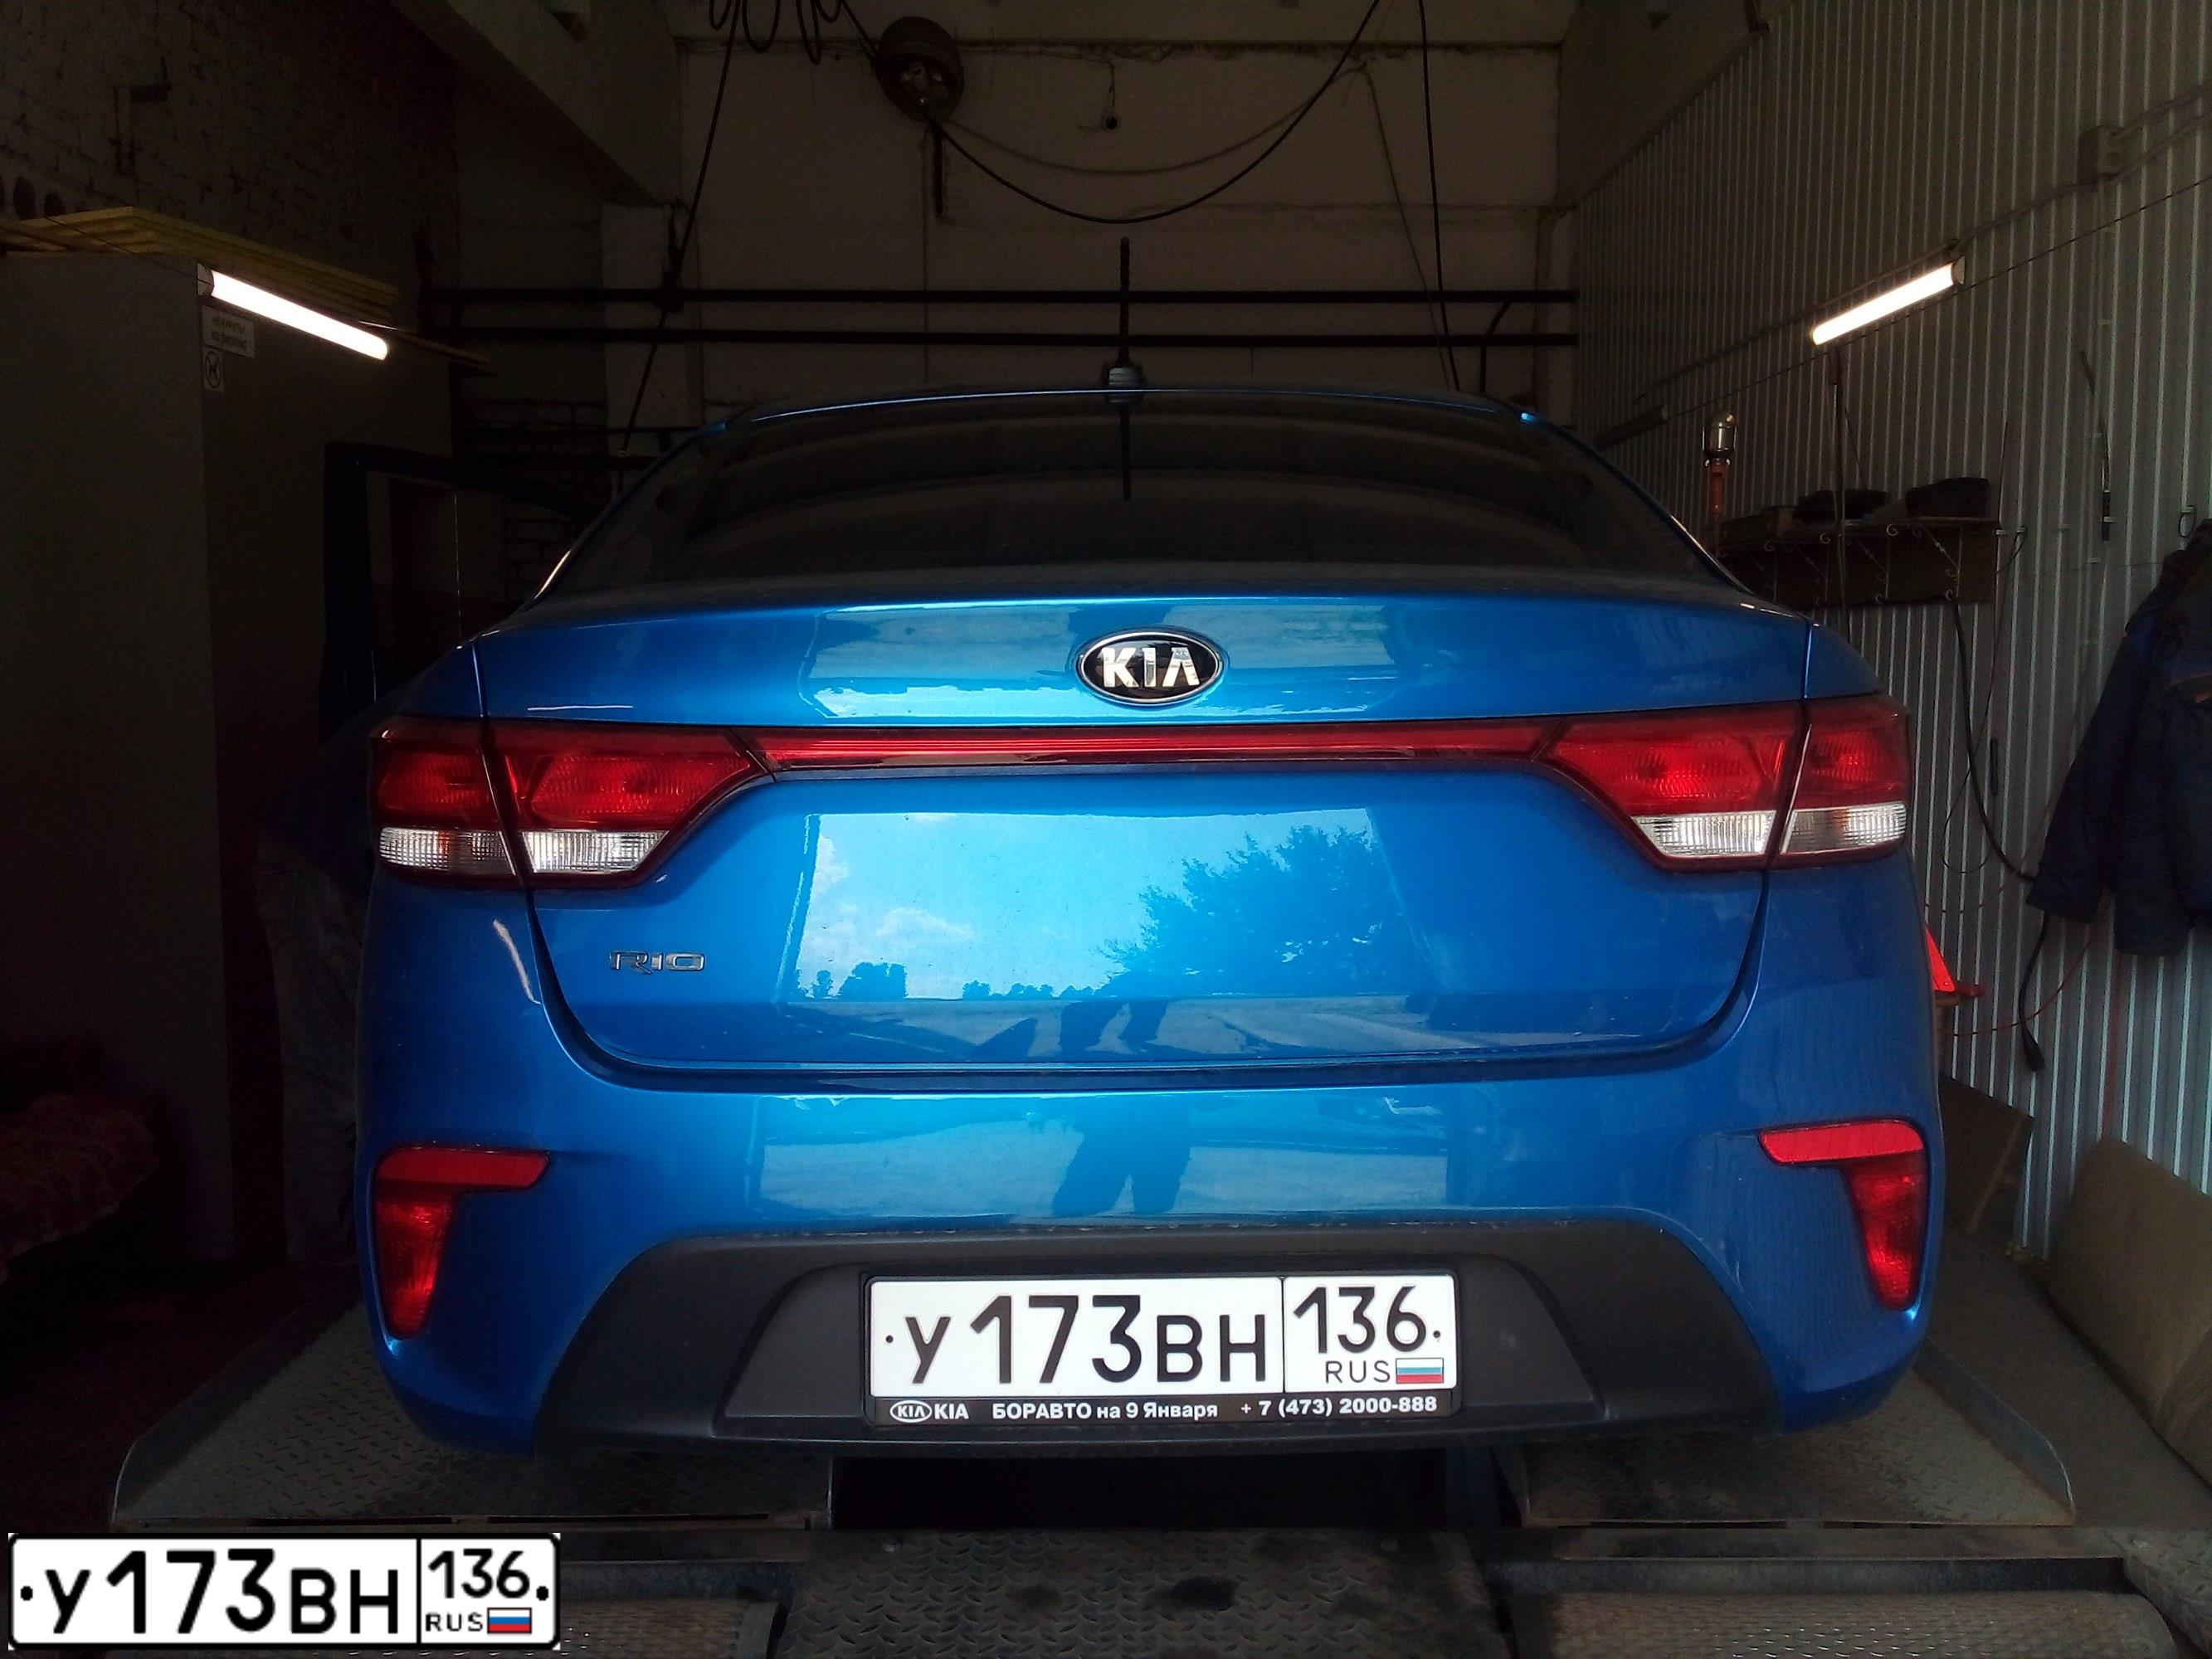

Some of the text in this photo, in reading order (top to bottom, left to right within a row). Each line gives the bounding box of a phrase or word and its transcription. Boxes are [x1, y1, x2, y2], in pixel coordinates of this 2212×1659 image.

[1101, 647, 1201, 688] KIA
[609, 951, 707, 975] RIO
[1293, 1286, 1427, 1355] 136
[1325, 1360, 1391, 1384] RUS
[897, 1405, 926, 1418] KIA
[934, 1403, 970, 1420] KIA
[992, 1402, 1218, 1421] БОРАВТО на 9 Января
[1258, 1400, 1272, 1416] 7
[1279, 1398, 1333, 1418] (473)
[1339, 1395, 1438, 1414] 2000-888
